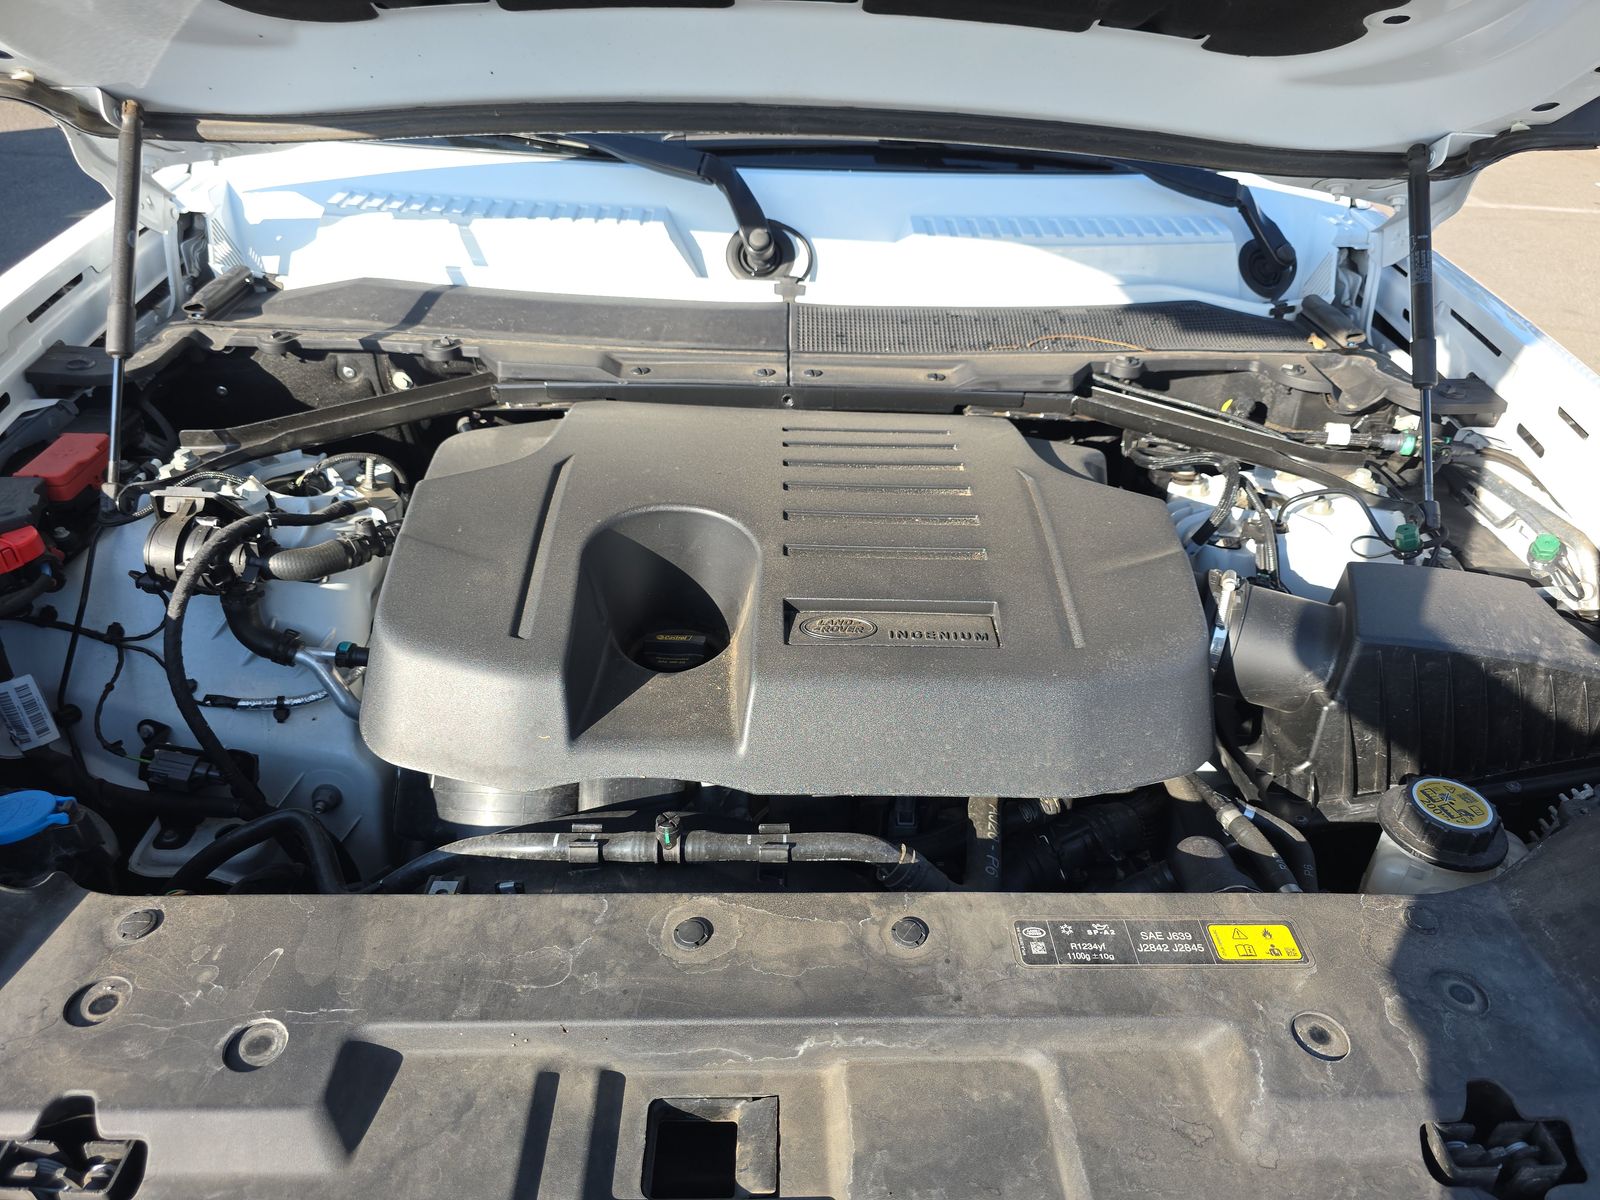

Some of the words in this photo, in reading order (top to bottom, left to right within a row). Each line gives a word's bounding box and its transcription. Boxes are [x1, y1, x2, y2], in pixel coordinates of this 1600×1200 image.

[819, 625, 865, 634] ROVER
[889, 630, 990, 641] INGENIUM
[1140, 931, 1163, 941] SAE
[1166, 931, 1193, 941] J639
[1070, 942, 1106, 952] R1234yf
[1137, 944, 1169, 953] J2842
[1172, 944, 1205, 954] J2845
[1067, 952, 1091, 961] 1100g
